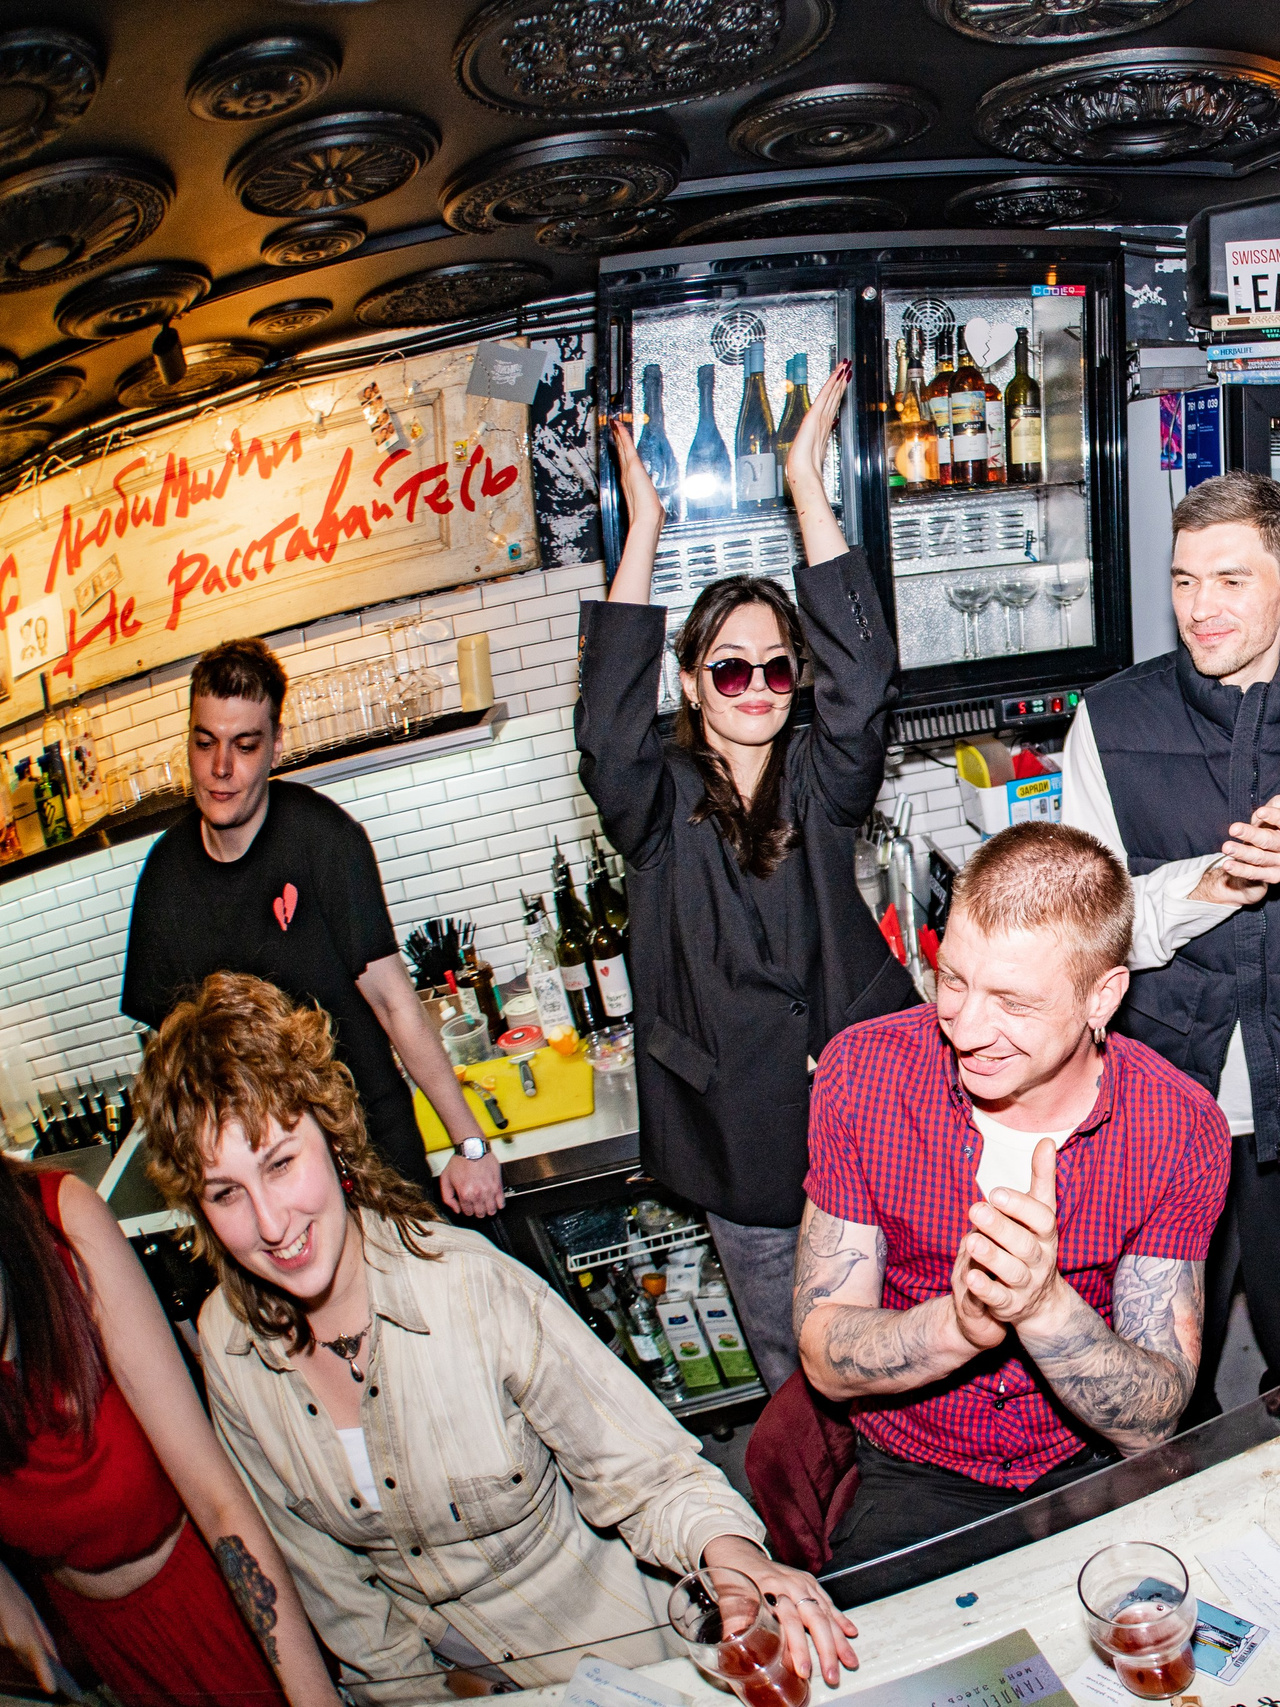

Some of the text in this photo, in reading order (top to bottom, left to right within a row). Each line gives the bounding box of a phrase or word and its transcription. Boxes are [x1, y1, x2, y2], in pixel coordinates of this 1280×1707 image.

[1220, 347, 1253, 356] HERBALIFE
[1019, 780, 1050, 797] ЗАРЯДИ
[947, 1684, 990, 1705] здесь
